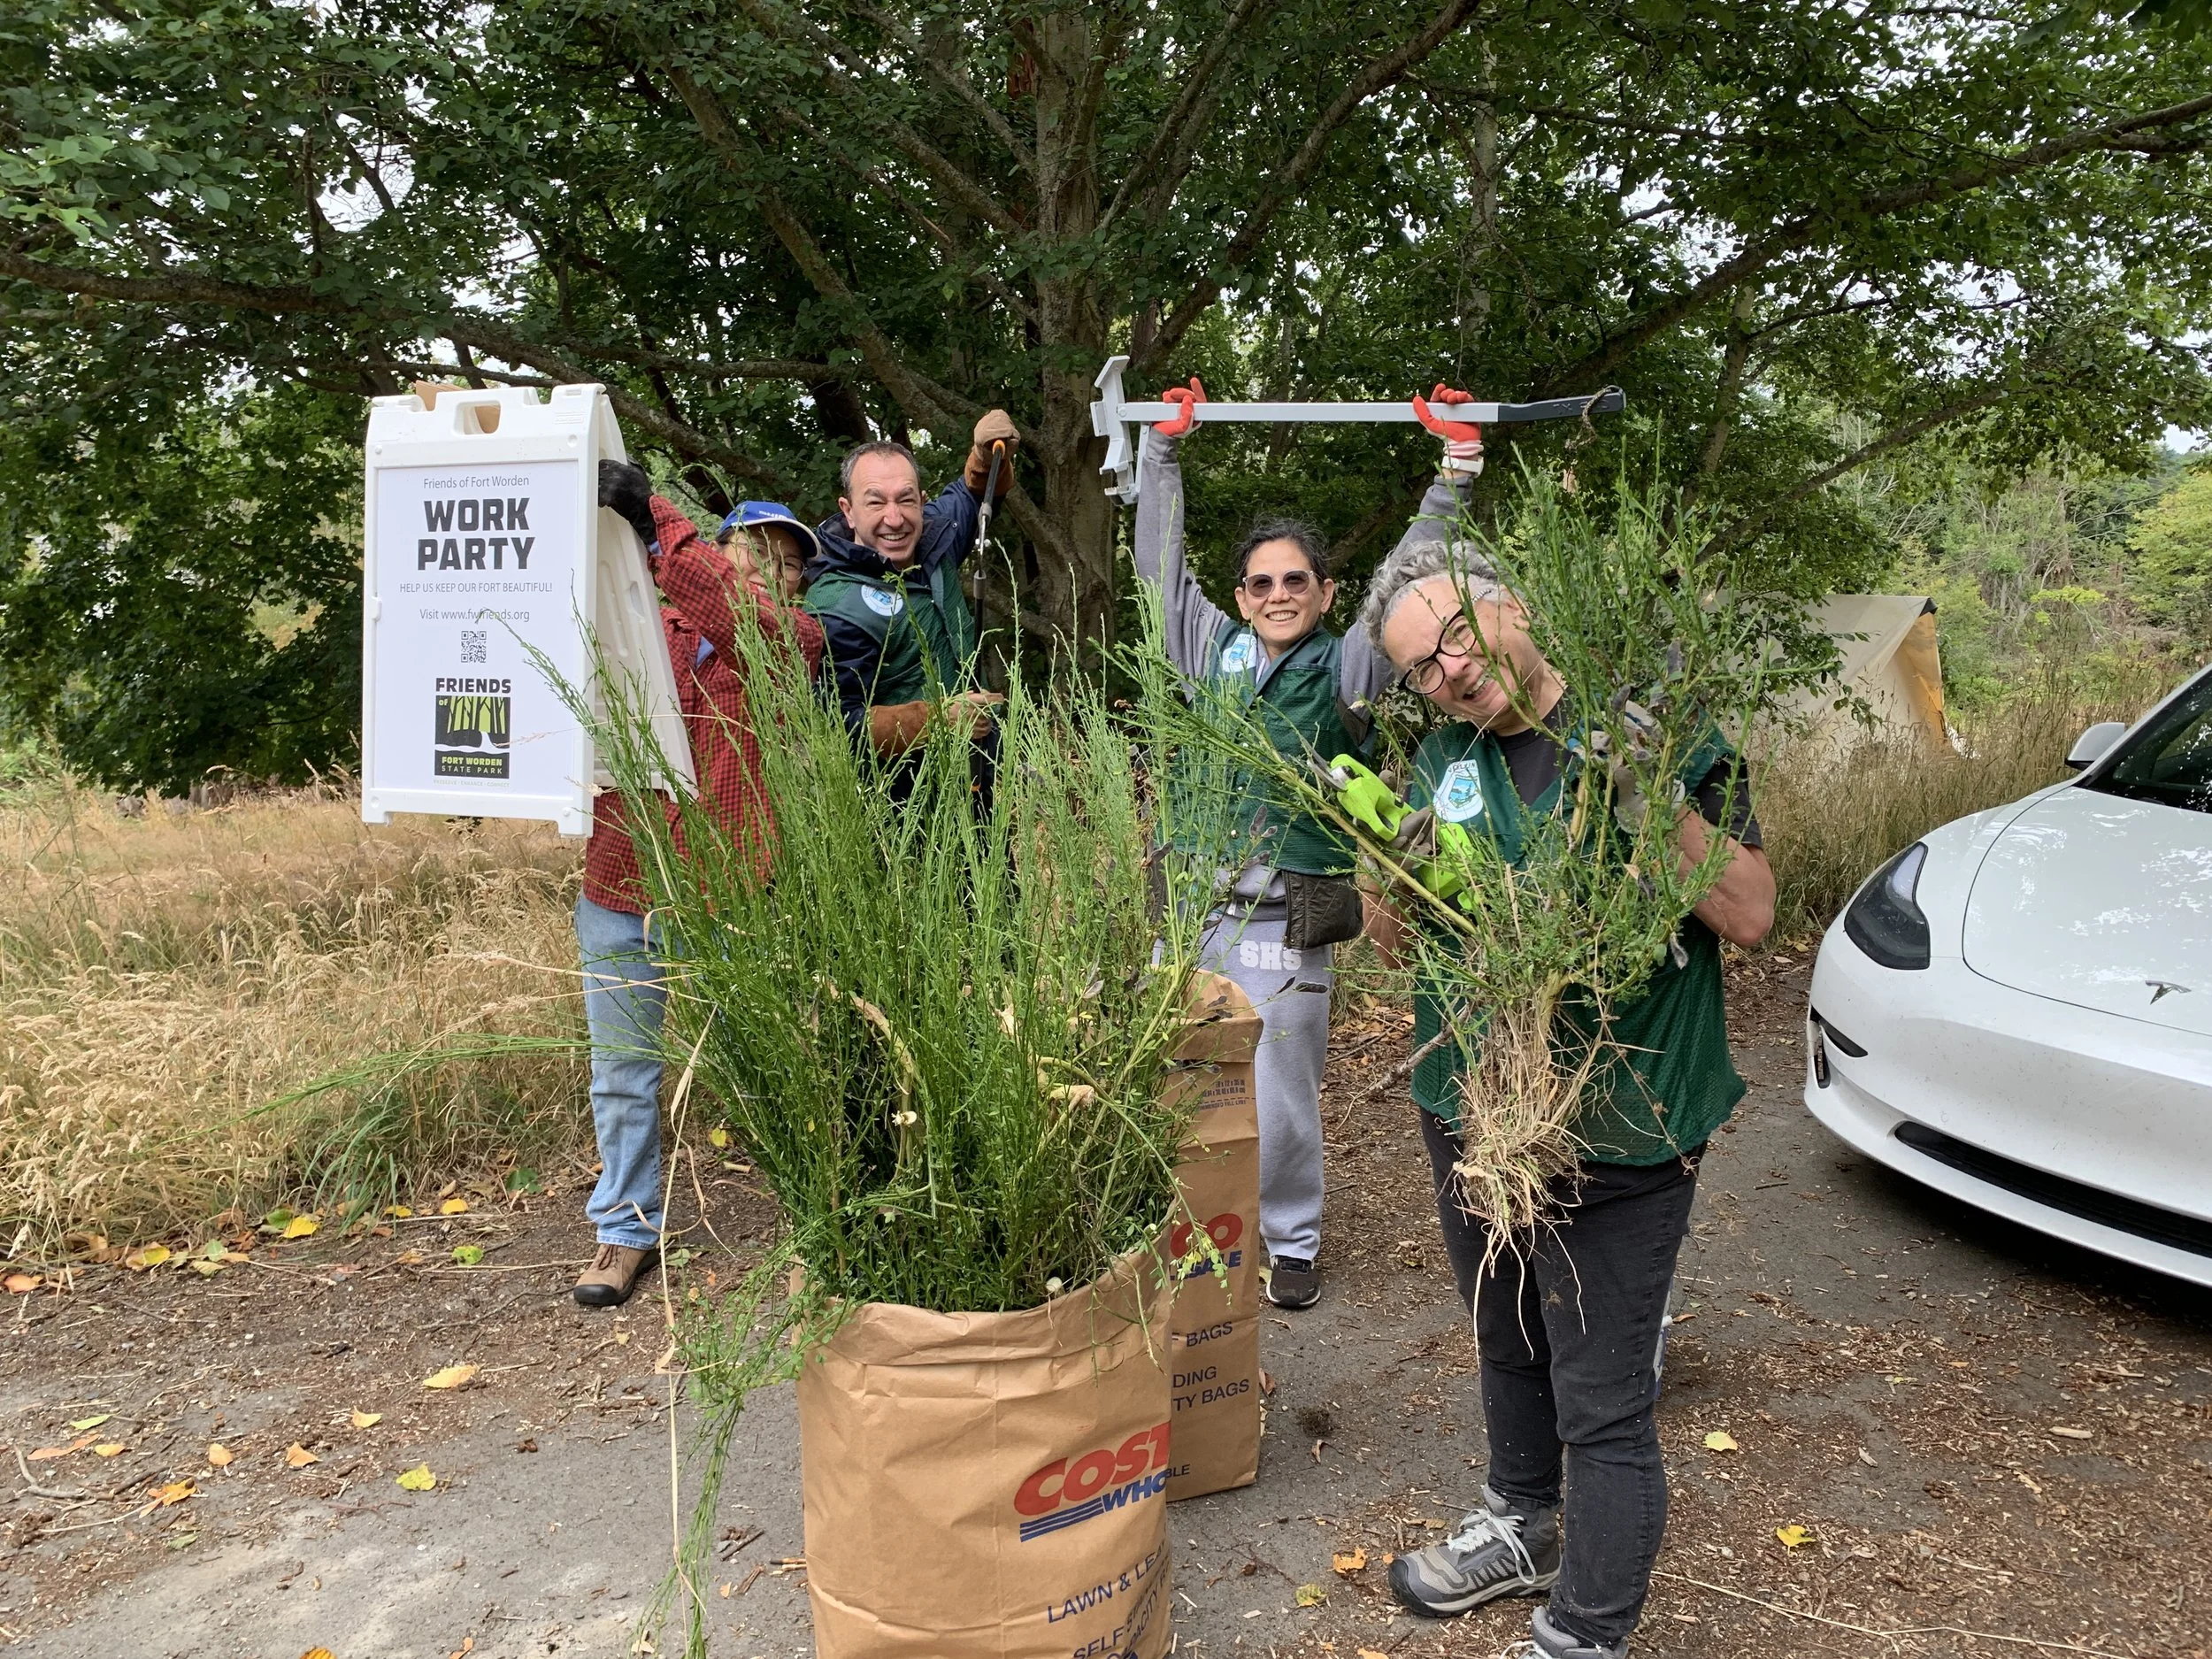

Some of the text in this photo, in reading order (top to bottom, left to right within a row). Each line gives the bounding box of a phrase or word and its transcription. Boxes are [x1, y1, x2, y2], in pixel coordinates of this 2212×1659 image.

[423, 475, 530, 489] Friends of Fort Worden
[424, 497, 530, 532] WORK
[418, 536, 535, 571] PARTY
[399, 582, 553, 593] HELP US KEEP OUR FORT BEAUTIFUL!
[419, 608, 530, 623] Visit www.fwfriends.org
[435, 678, 511, 694] FRIENDS
[465, 757, 503, 766] WORDEN
[1240, 940, 1302, 971] SHS
[1187, 1321, 1233, 1348] BAGS
[1172, 1366, 1217, 1388] DING
[1173, 1379, 1249, 1411] TY BAGS
[1014, 1420, 1171, 1516] COST
[1102, 1471, 1168, 1512] WHO
[1048, 1581, 1113, 1624] LAWN
[1119, 1572, 1132, 1592] &
[1072, 1624, 1125, 1659] SELF
